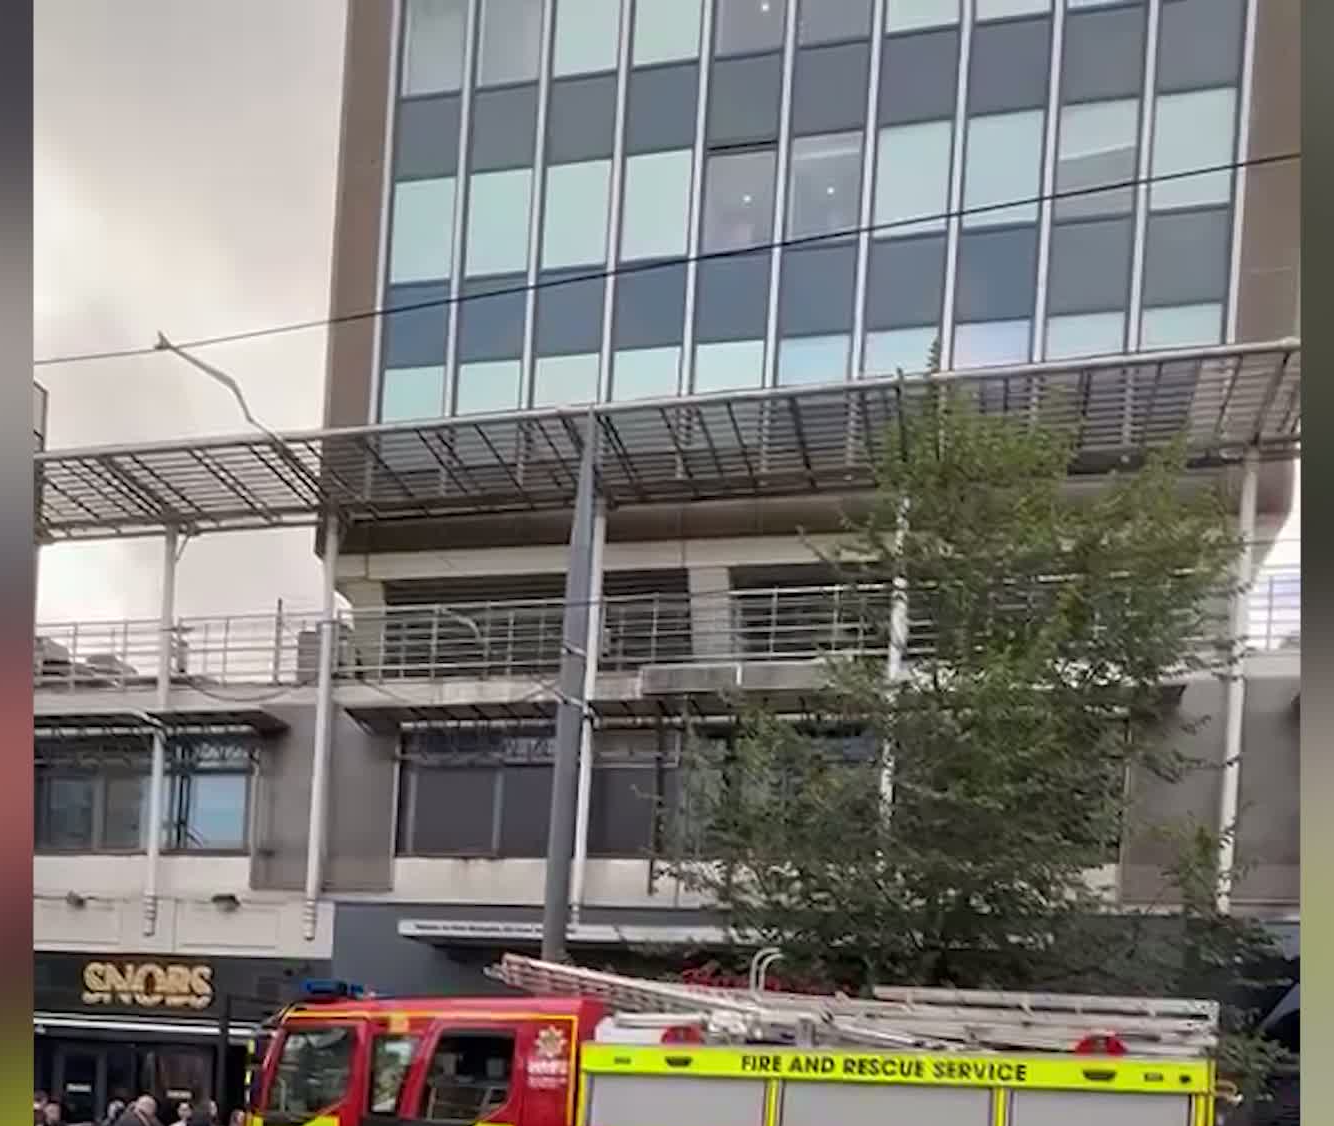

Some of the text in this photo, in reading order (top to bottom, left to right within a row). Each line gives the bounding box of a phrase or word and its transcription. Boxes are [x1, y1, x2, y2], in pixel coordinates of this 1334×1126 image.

[83, 961, 213, 1008] SNOBS
[741, 1055, 1027, 1081] FIRE AND RESCUE SERVICE
